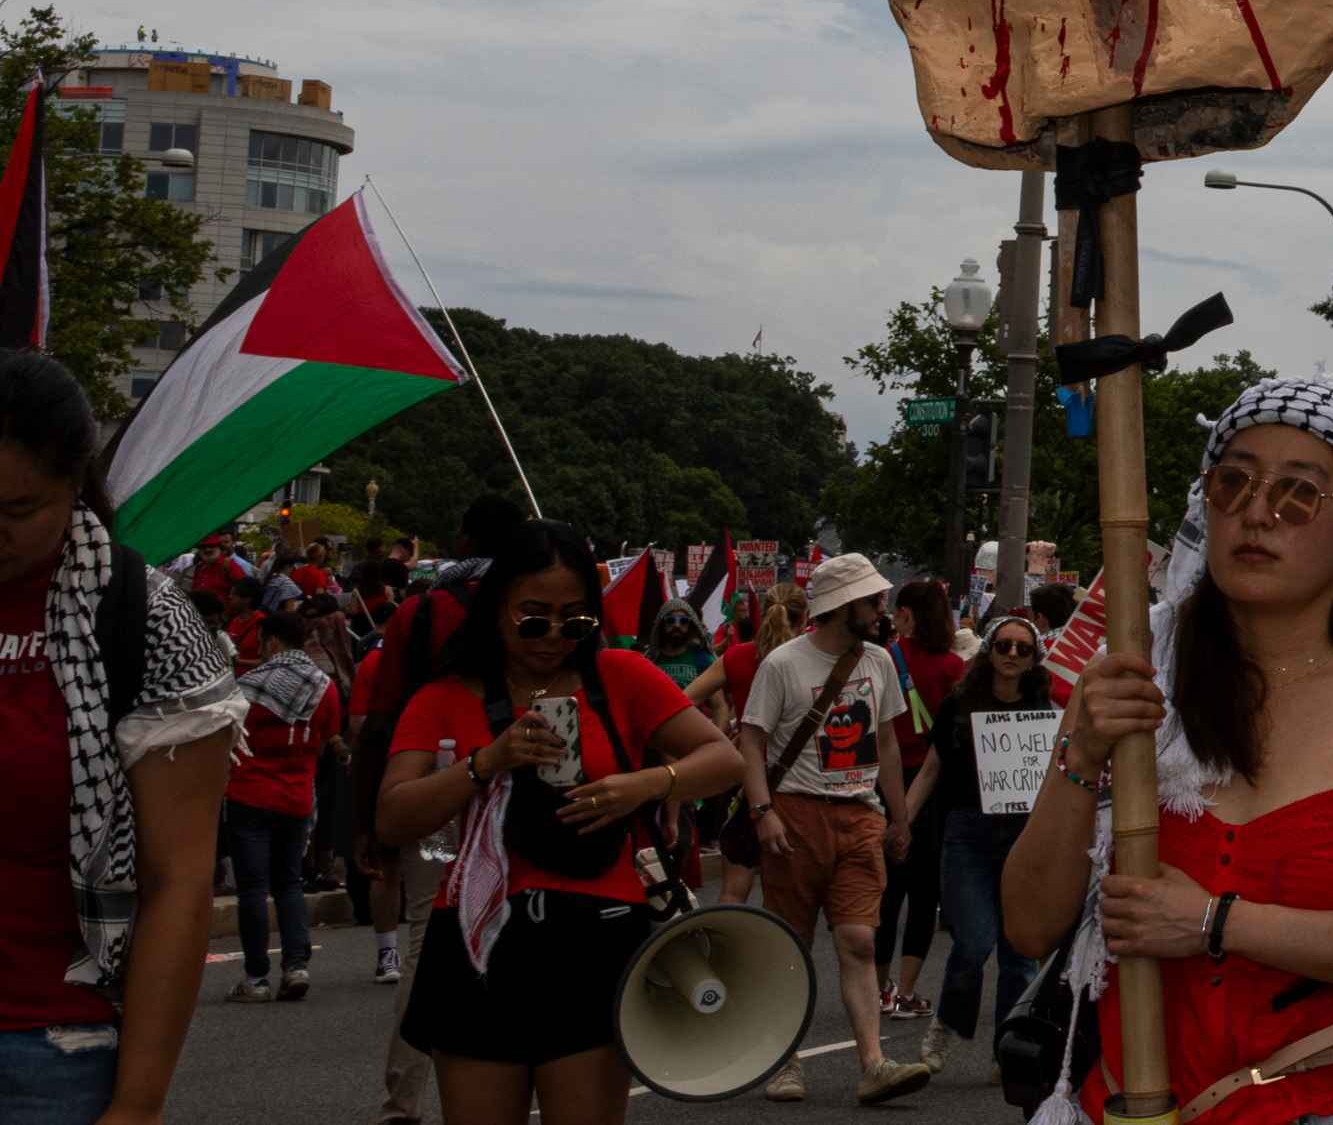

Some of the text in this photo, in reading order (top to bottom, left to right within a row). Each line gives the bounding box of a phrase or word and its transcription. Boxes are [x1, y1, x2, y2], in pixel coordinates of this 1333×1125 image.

[985, 713, 1011, 724] ARMS
[981, 731, 1011, 754] NO
[979, 767, 1048, 793] WAR CRIM
[1004, 801, 1030, 813] FREE
